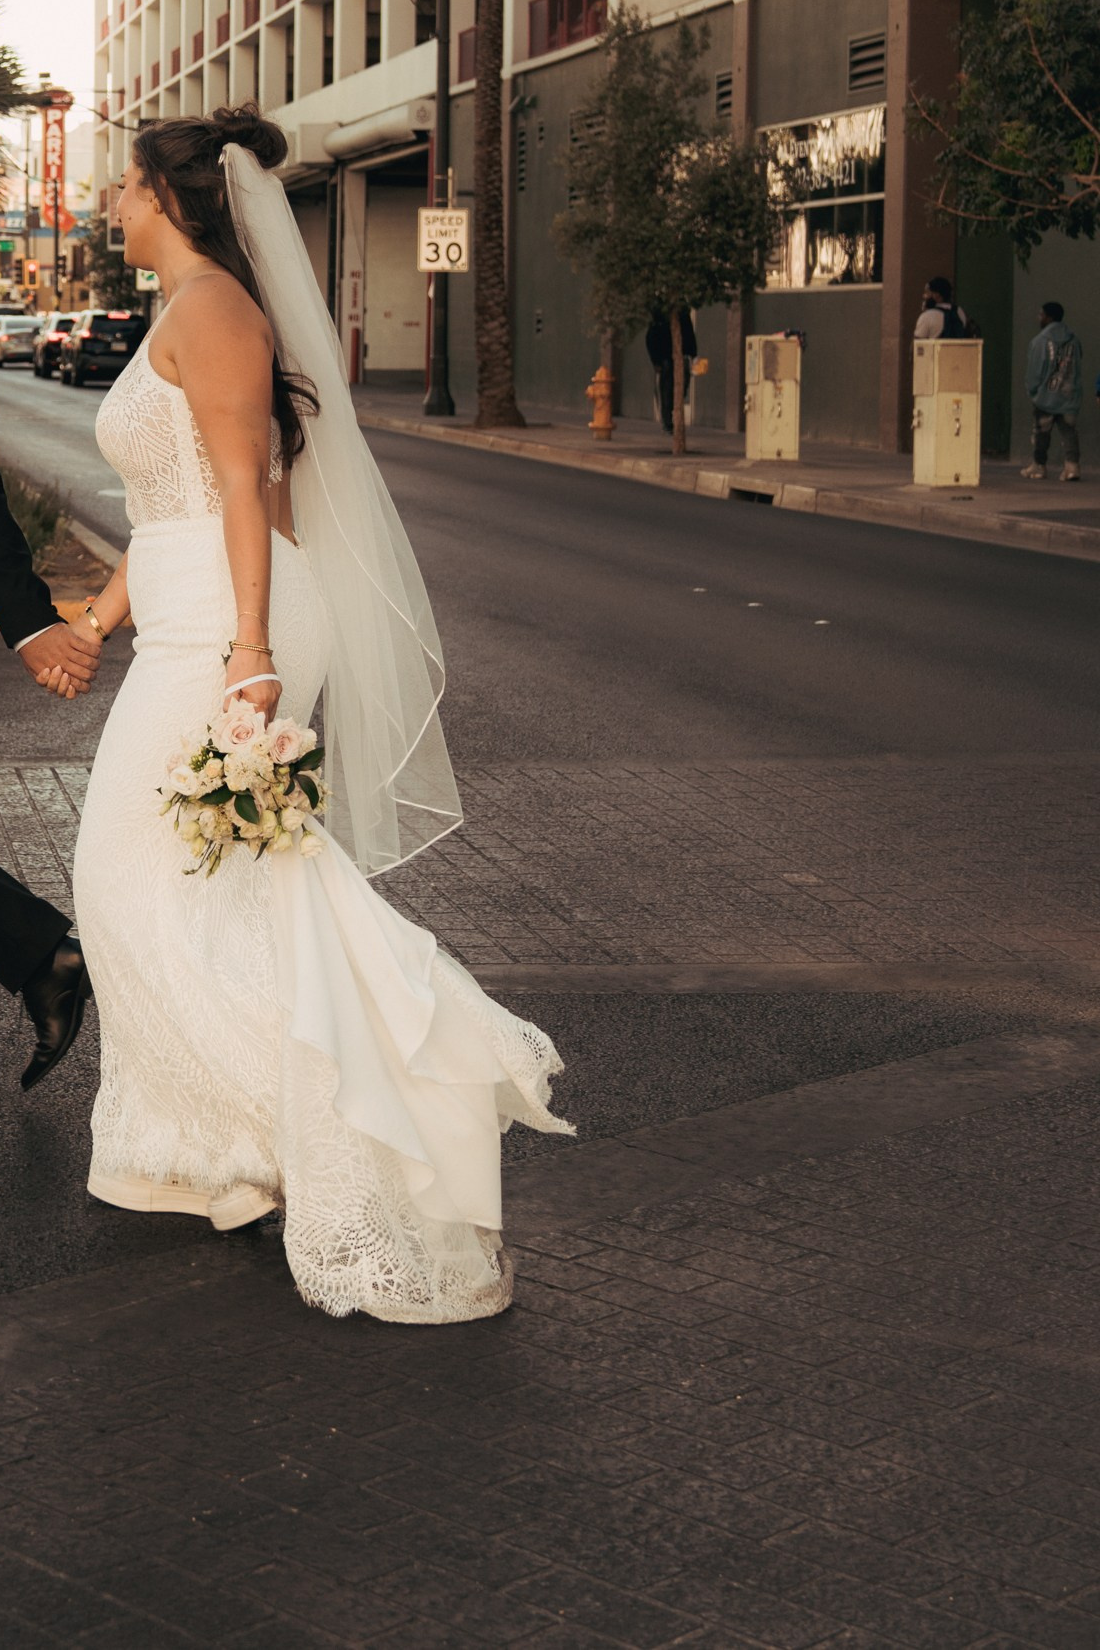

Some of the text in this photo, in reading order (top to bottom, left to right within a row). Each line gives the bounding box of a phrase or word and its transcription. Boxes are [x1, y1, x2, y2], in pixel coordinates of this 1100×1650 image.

[46, 108, 63, 207] PARKING
[424, 215, 464, 225] SPEED
[428, 229, 459, 238] LIMIT
[426, 242, 462, 263] 30
